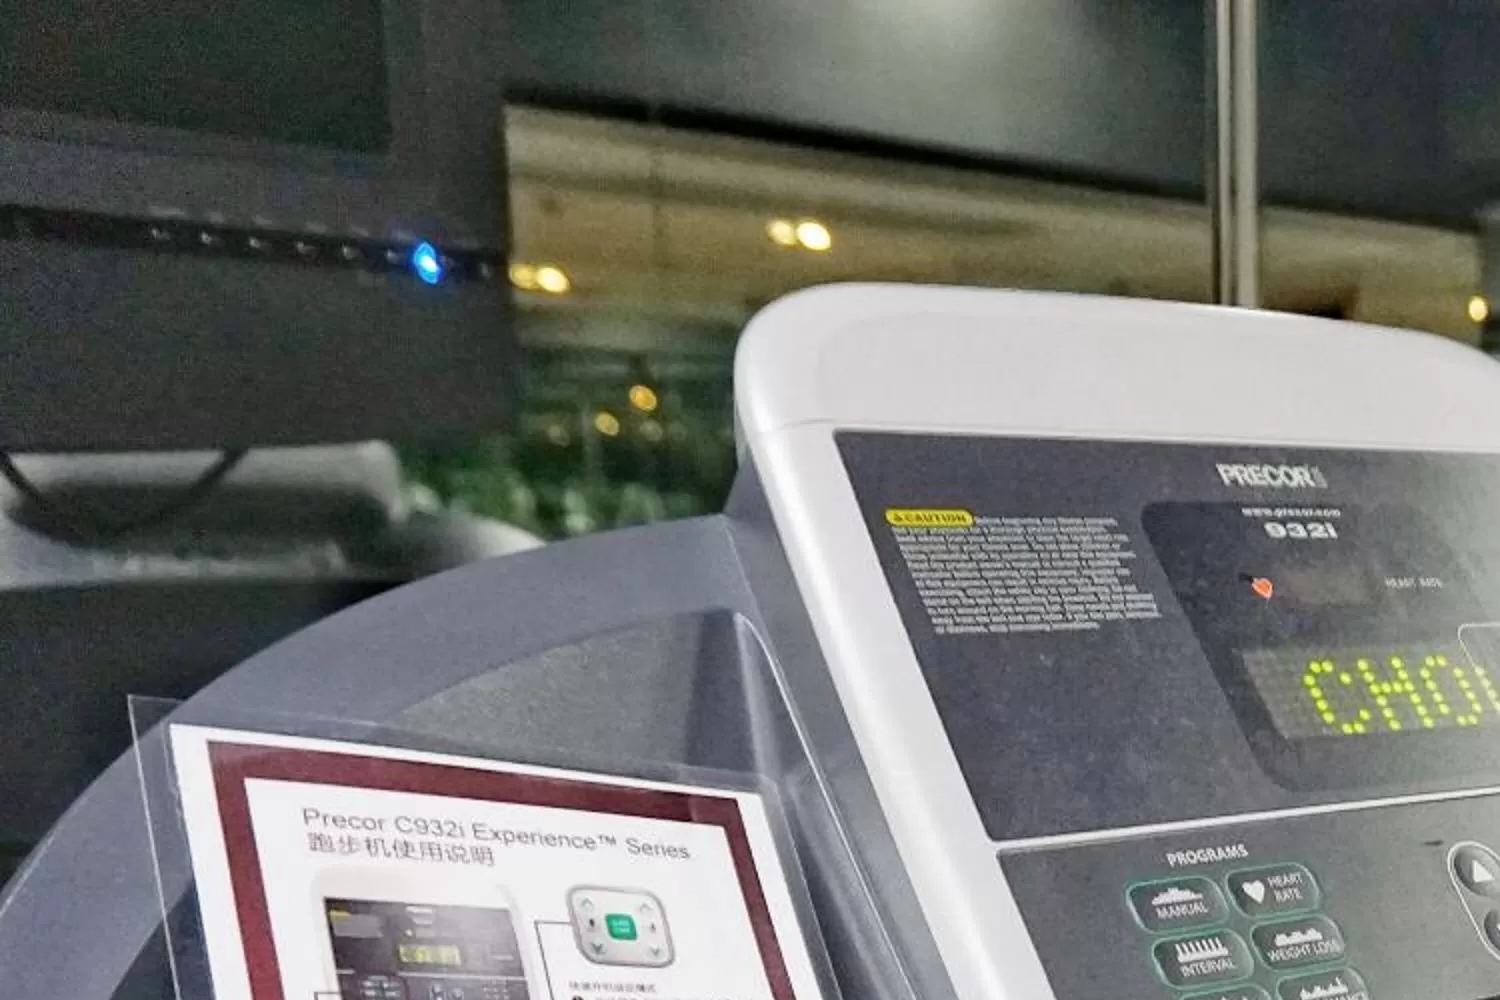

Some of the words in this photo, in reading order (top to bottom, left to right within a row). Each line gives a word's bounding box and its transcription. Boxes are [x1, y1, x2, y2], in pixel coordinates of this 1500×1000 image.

[1216, 464, 1315, 488] PRECOR
[903, 513, 967, 524] CAUTION
[1264, 521, 1338, 540] 932i
[302, 806, 386, 832] Precor
[395, 815, 465, 839] C932i
[625, 836, 691, 860] Series
[308, 831, 496, 866] 跑步机使用说明
[1166, 844, 1249, 868] PROGRAMS
[1267, 872, 1304, 886] HEART
[1274, 887, 1304, 902] RATE
[1156, 902, 1209, 920] MANUAL
[1268, 943, 1312, 962] WEIGHT
[1180, 957, 1238, 977] INTERVAL
